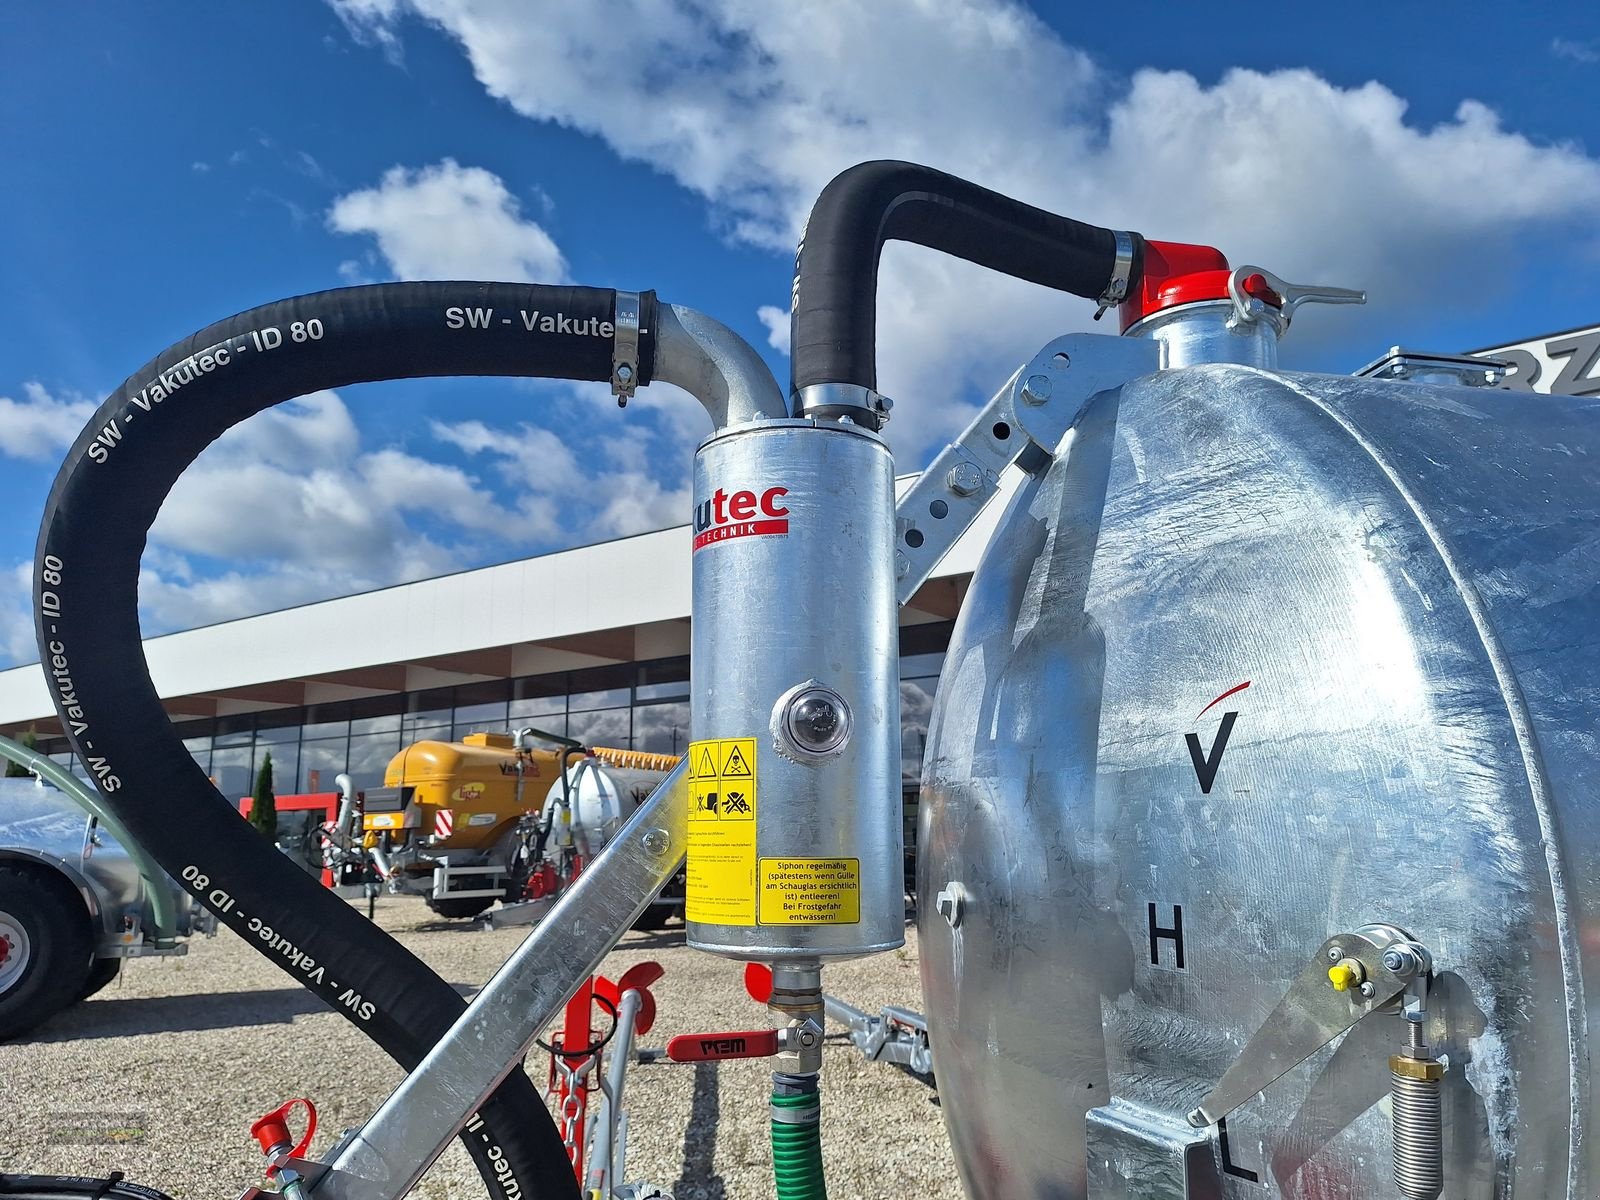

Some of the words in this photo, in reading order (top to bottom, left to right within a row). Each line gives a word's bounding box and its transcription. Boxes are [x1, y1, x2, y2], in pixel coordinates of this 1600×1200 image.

[445, 307, 493, 329] SW
[520, 310, 615, 338] Vakute
[88, 419, 122, 464] SW
[132, 347, 231, 412] Vakutec
[252, 327, 283, 353] ID
[290, 318, 324, 343] 80
[694, 487, 790, 534] utec
[43, 554, 63, 586] 80
[42, 591, 61, 617] ID
[50, 640, 89, 736] Vakutec
[1184, 711, 1239, 794] V
[88, 756, 122, 793] SW
[181, 865, 210, 891] 80
[768, 872, 812, 880] (spätestens
[837, 872, 855, 880] Gülle
[777, 862, 804, 871] Siphon
[806, 862, 847, 871] regelmäßig
[208, 889, 236, 913] ID
[779, 882, 817, 891] Schauglas
[819, 882, 857, 890] ersichtlich
[784, 892, 797, 901] ist)
[799, 892, 840, 900] entleeren!
[783, 902, 796, 910] Bei
[798, 902, 842, 911] Frostgefahr
[789, 912, 836, 921] entwässern!
[247, 917, 326, 985] Vakutec
[1148, 903, 1185, 968] H
[338, 988, 376, 1021] SW
[1217, 1116, 1259, 1183] L
